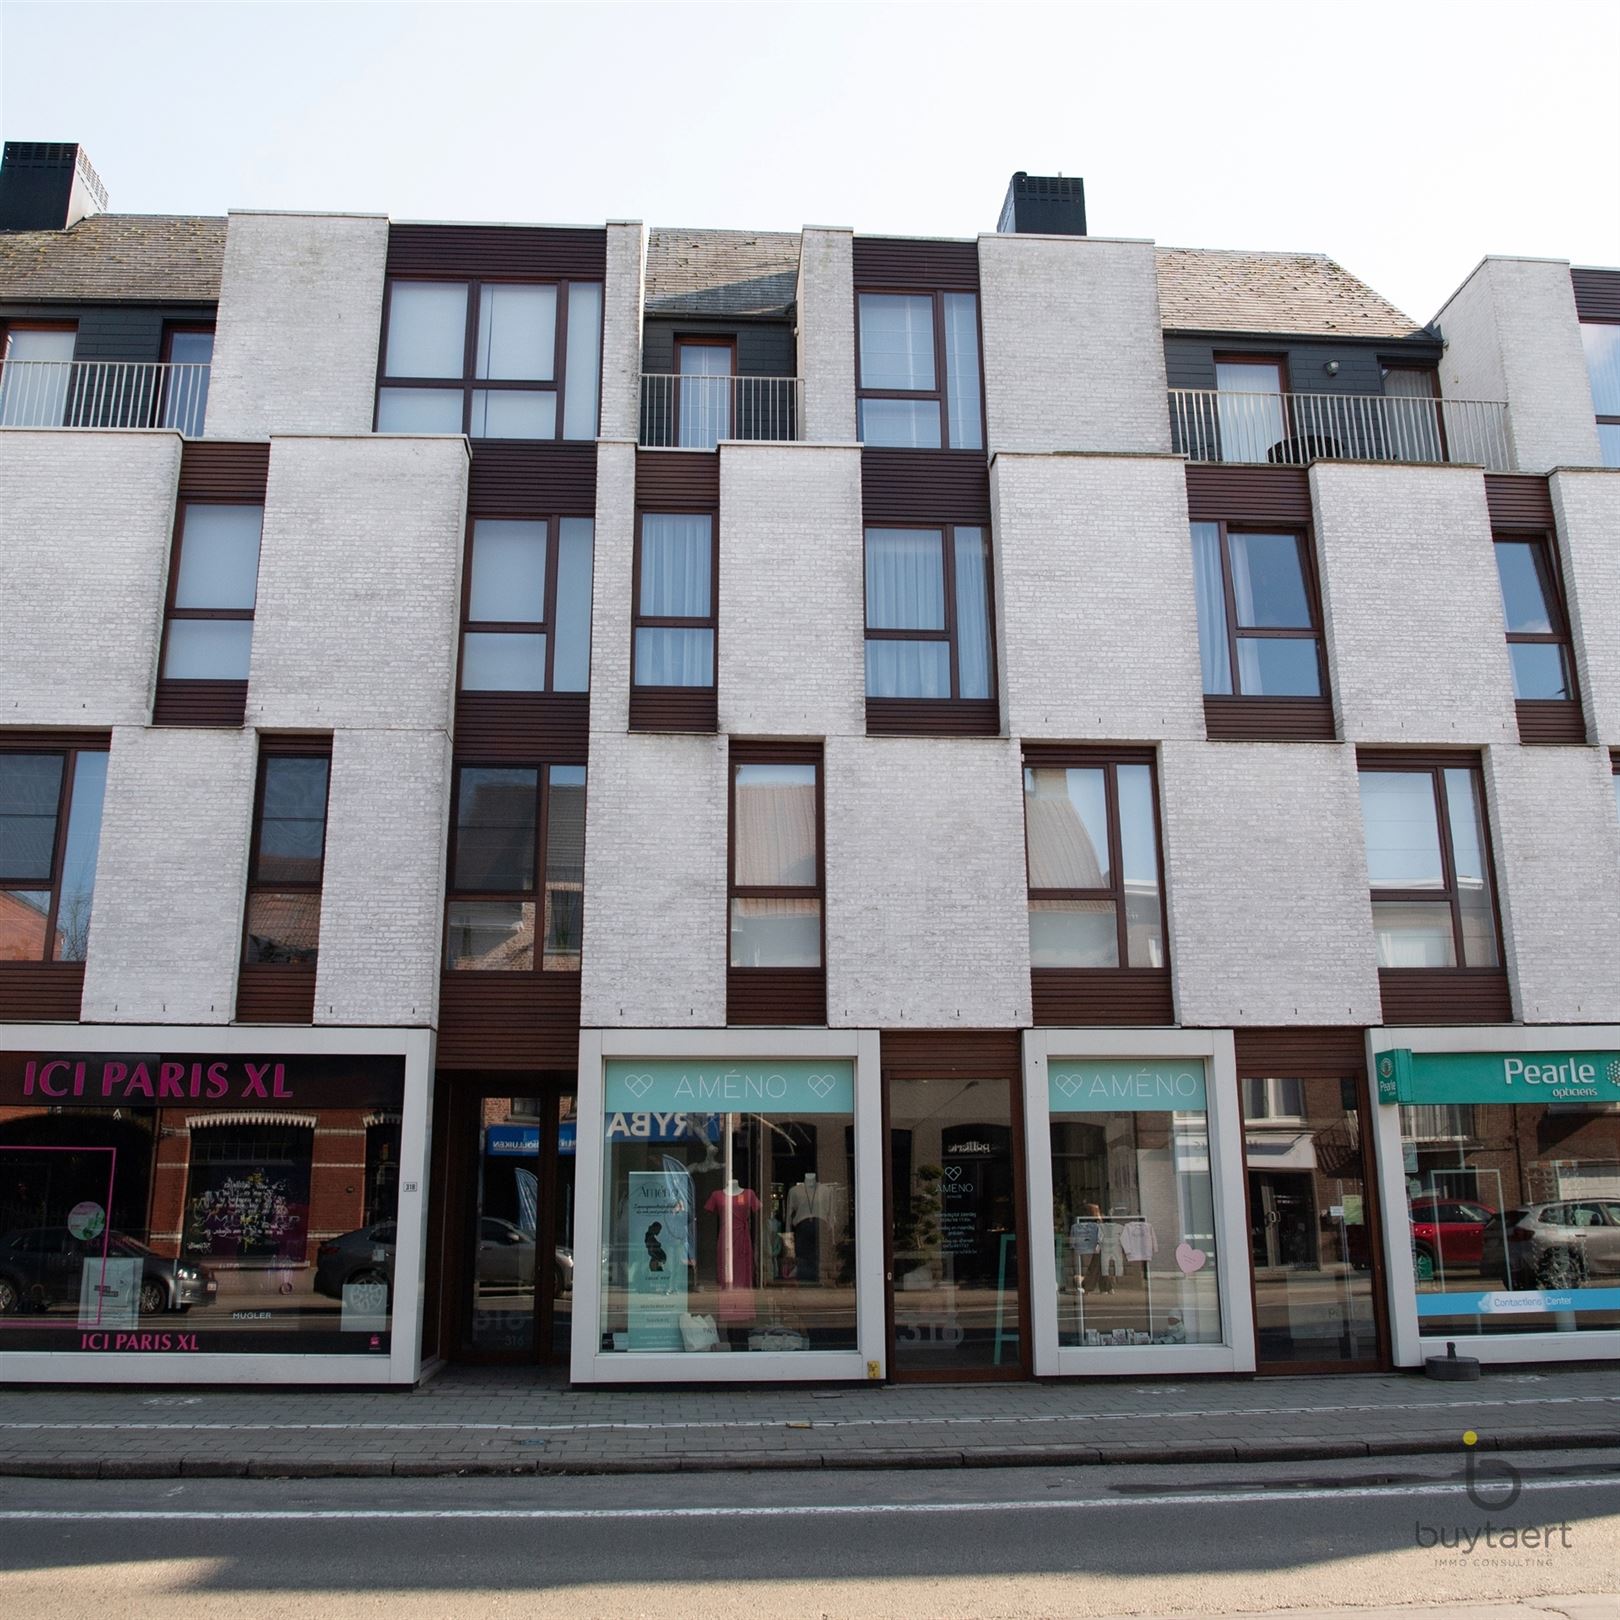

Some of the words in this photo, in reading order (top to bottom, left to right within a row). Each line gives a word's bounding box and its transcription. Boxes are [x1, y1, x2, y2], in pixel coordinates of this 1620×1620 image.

[24, 1061, 86, 1097] ICI
[102, 1062, 229, 1098] PARIS
[241, 1063, 293, 1098] XL
[1503, 1057, 1596, 1085] Pearle
[673, 1069, 787, 1099] AMÉNO
[1088, 1067, 1197, 1097] AMÉNO
[1552, 1087, 1598, 1098] opticiens
[406, 1183, 416, 1191] 318
[1545, 1296, 1572, 1305] Center
[232, 1311, 272, 1319] MUGLER
[82, 1333, 109, 1349] ICI
[115, 1333, 172, 1350] PARIS
[176, 1334, 200, 1350] XL
